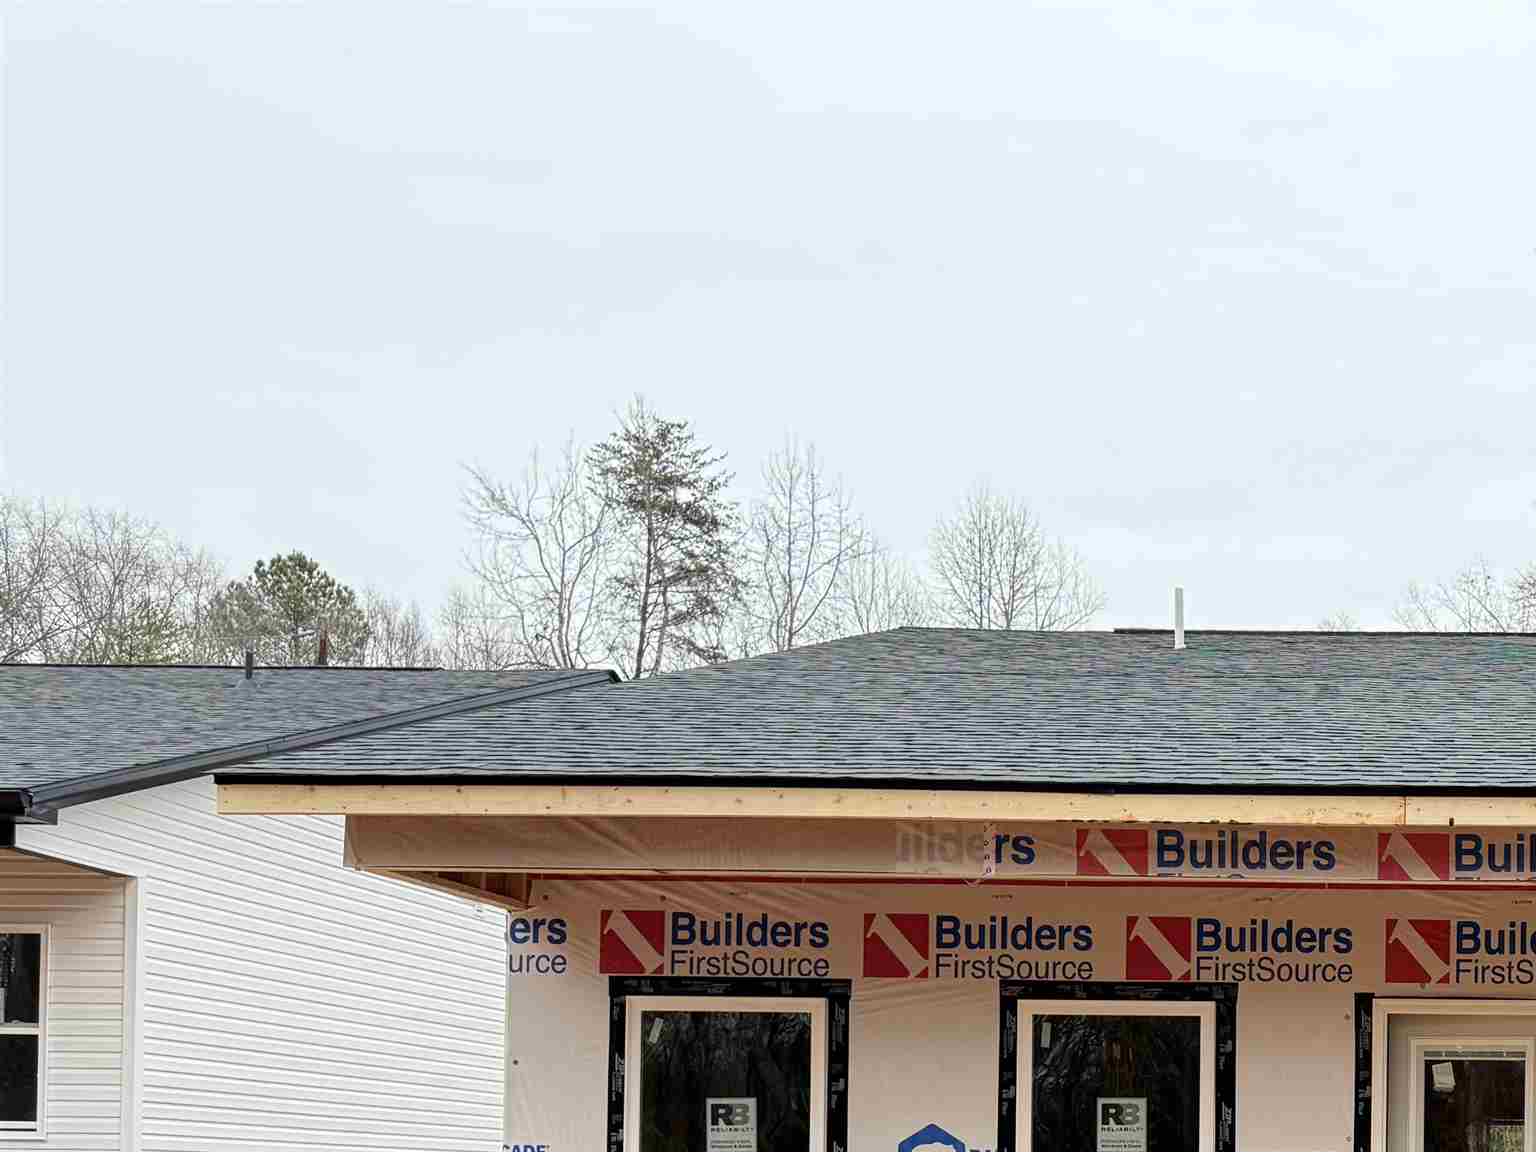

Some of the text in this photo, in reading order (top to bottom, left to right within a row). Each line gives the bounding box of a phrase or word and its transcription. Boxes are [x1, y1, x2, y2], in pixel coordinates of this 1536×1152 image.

[1156, 830, 1336, 869] Builders
[671, 913, 829, 946] Builders
[936, 915, 1093, 951] Builders
[1197, 919, 1352, 954] Builders
[671, 951, 829, 977] FirstSource
[936, 954, 1093, 980] FirstSource
[1197, 956, 1352, 983] FirstSource
